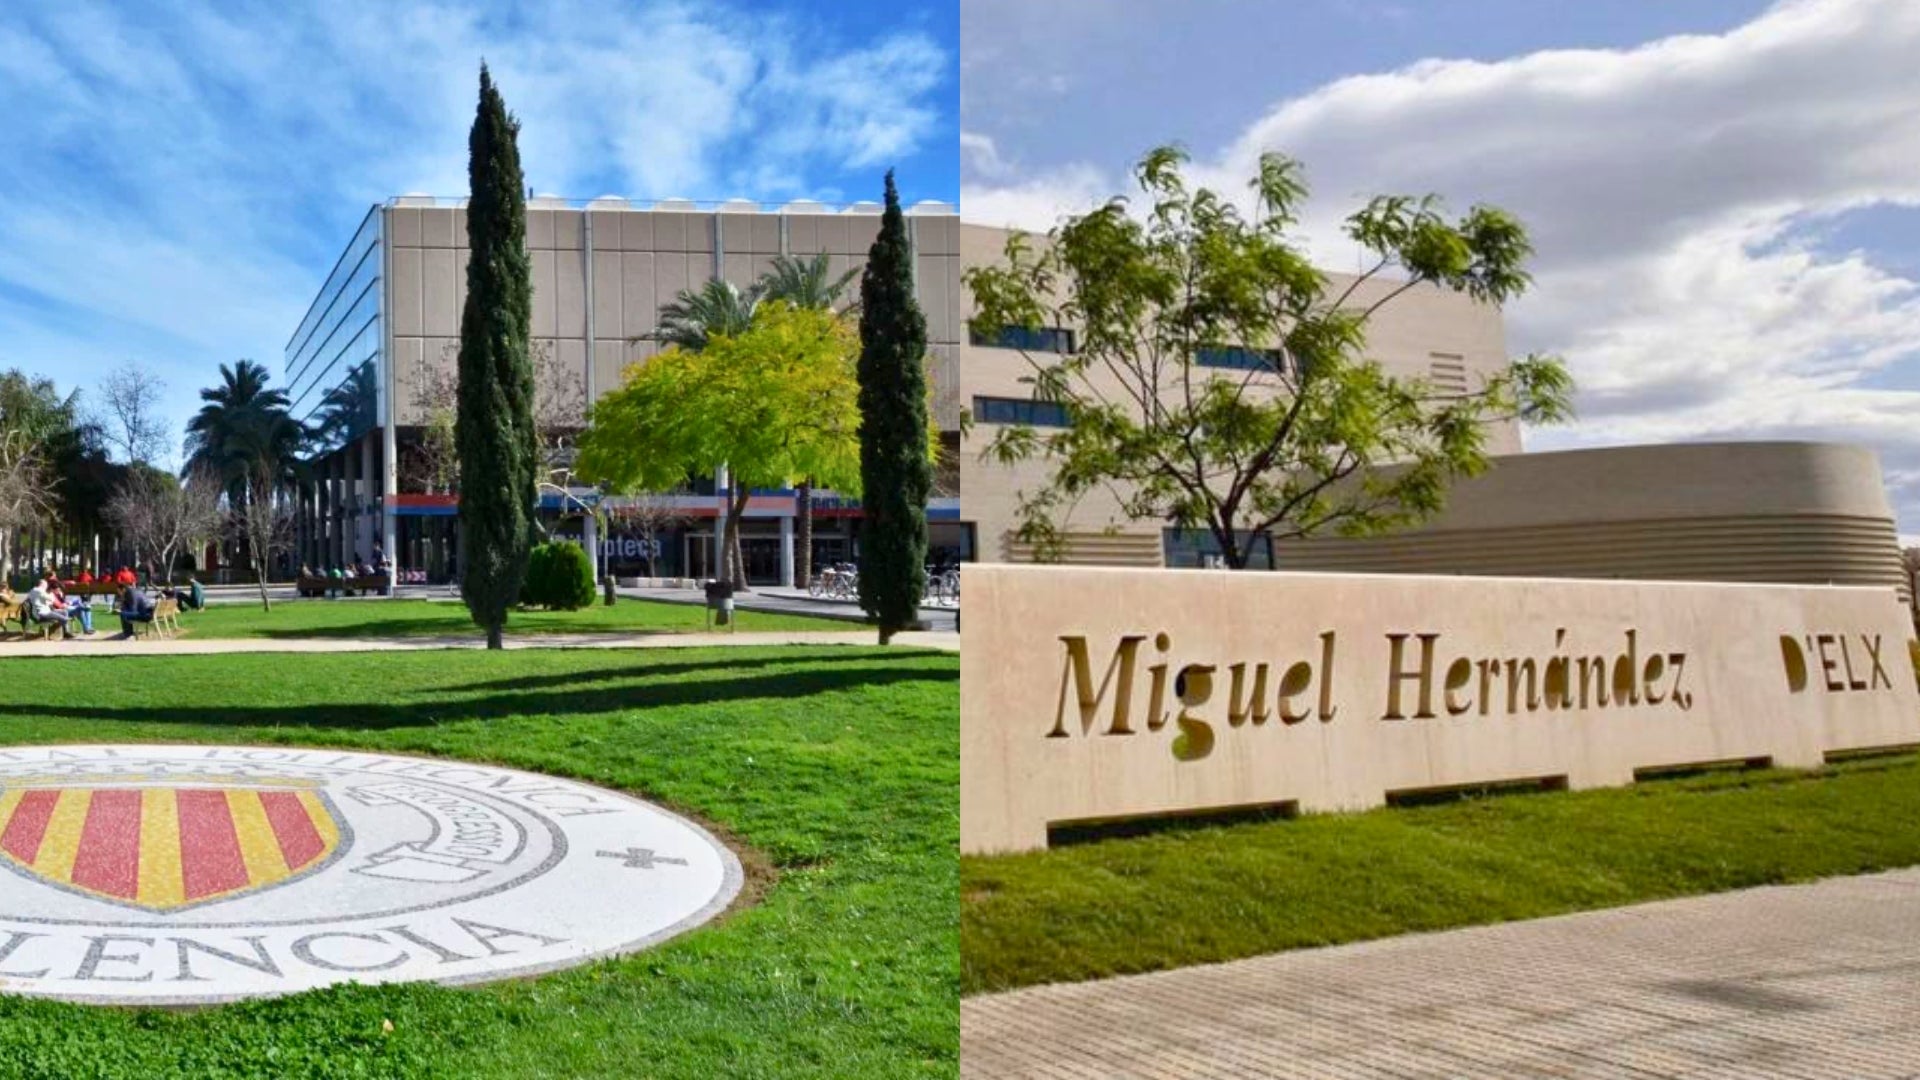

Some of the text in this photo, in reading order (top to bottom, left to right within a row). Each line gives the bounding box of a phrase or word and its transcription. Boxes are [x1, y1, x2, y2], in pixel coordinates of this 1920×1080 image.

[1045, 630, 1337, 762] Miguel
[1381, 628, 1692, 721] Hernández
[1780, 634, 1892, 693] D'ELX
